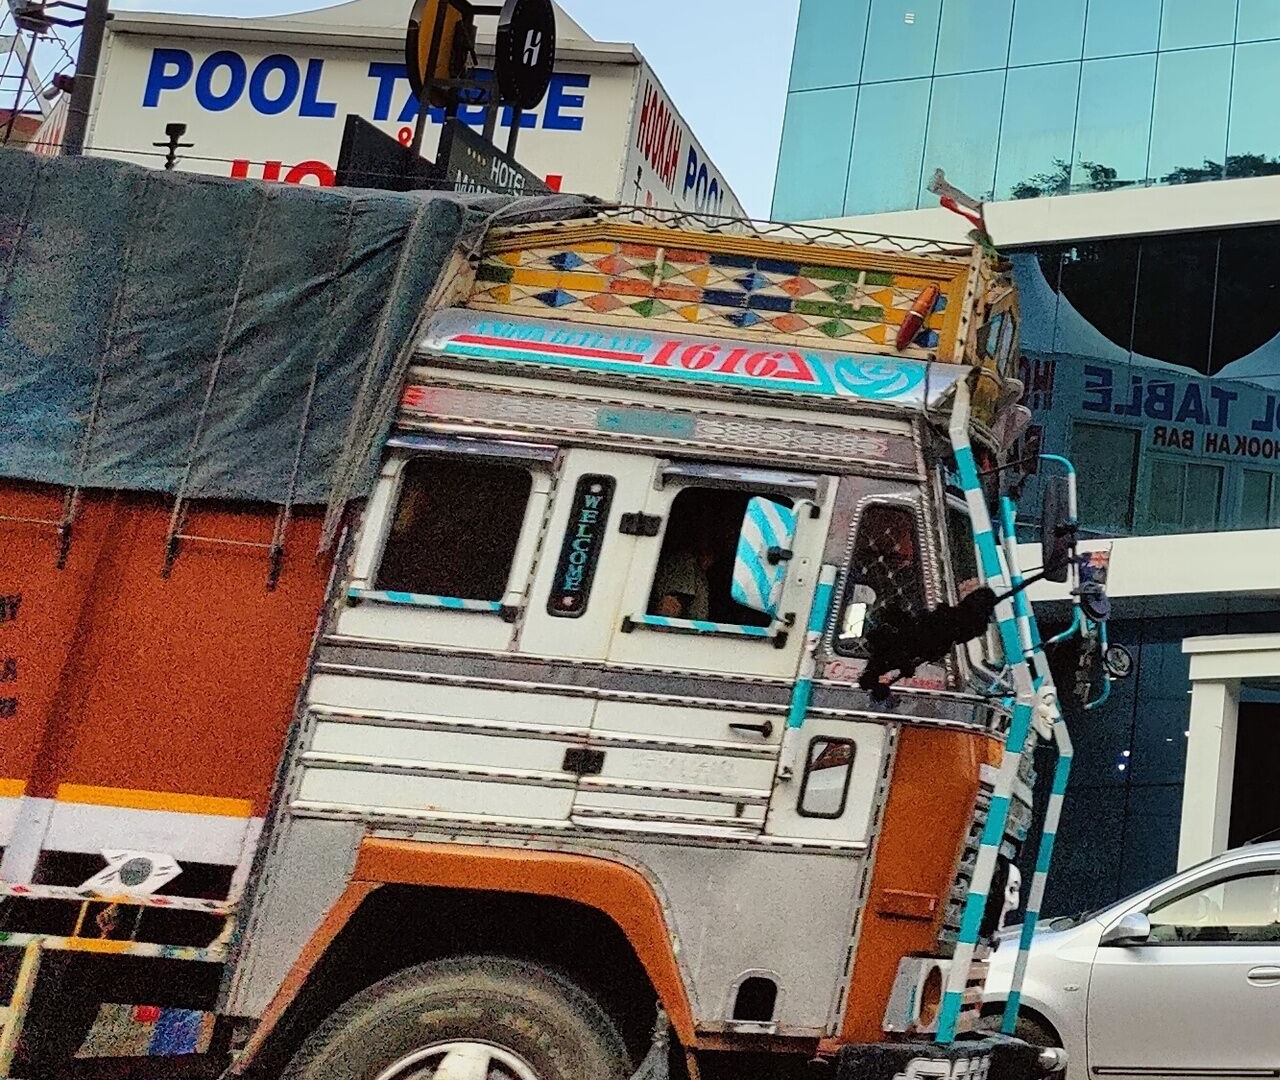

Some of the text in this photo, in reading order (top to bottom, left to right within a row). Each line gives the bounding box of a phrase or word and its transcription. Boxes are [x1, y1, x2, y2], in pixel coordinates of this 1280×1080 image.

[142, 47, 338, 120] POOL
[491, 156, 527, 196] HOTEL
[636, 78, 683, 196] HOOKAH
[562, 493, 603, 591] WELCOME
